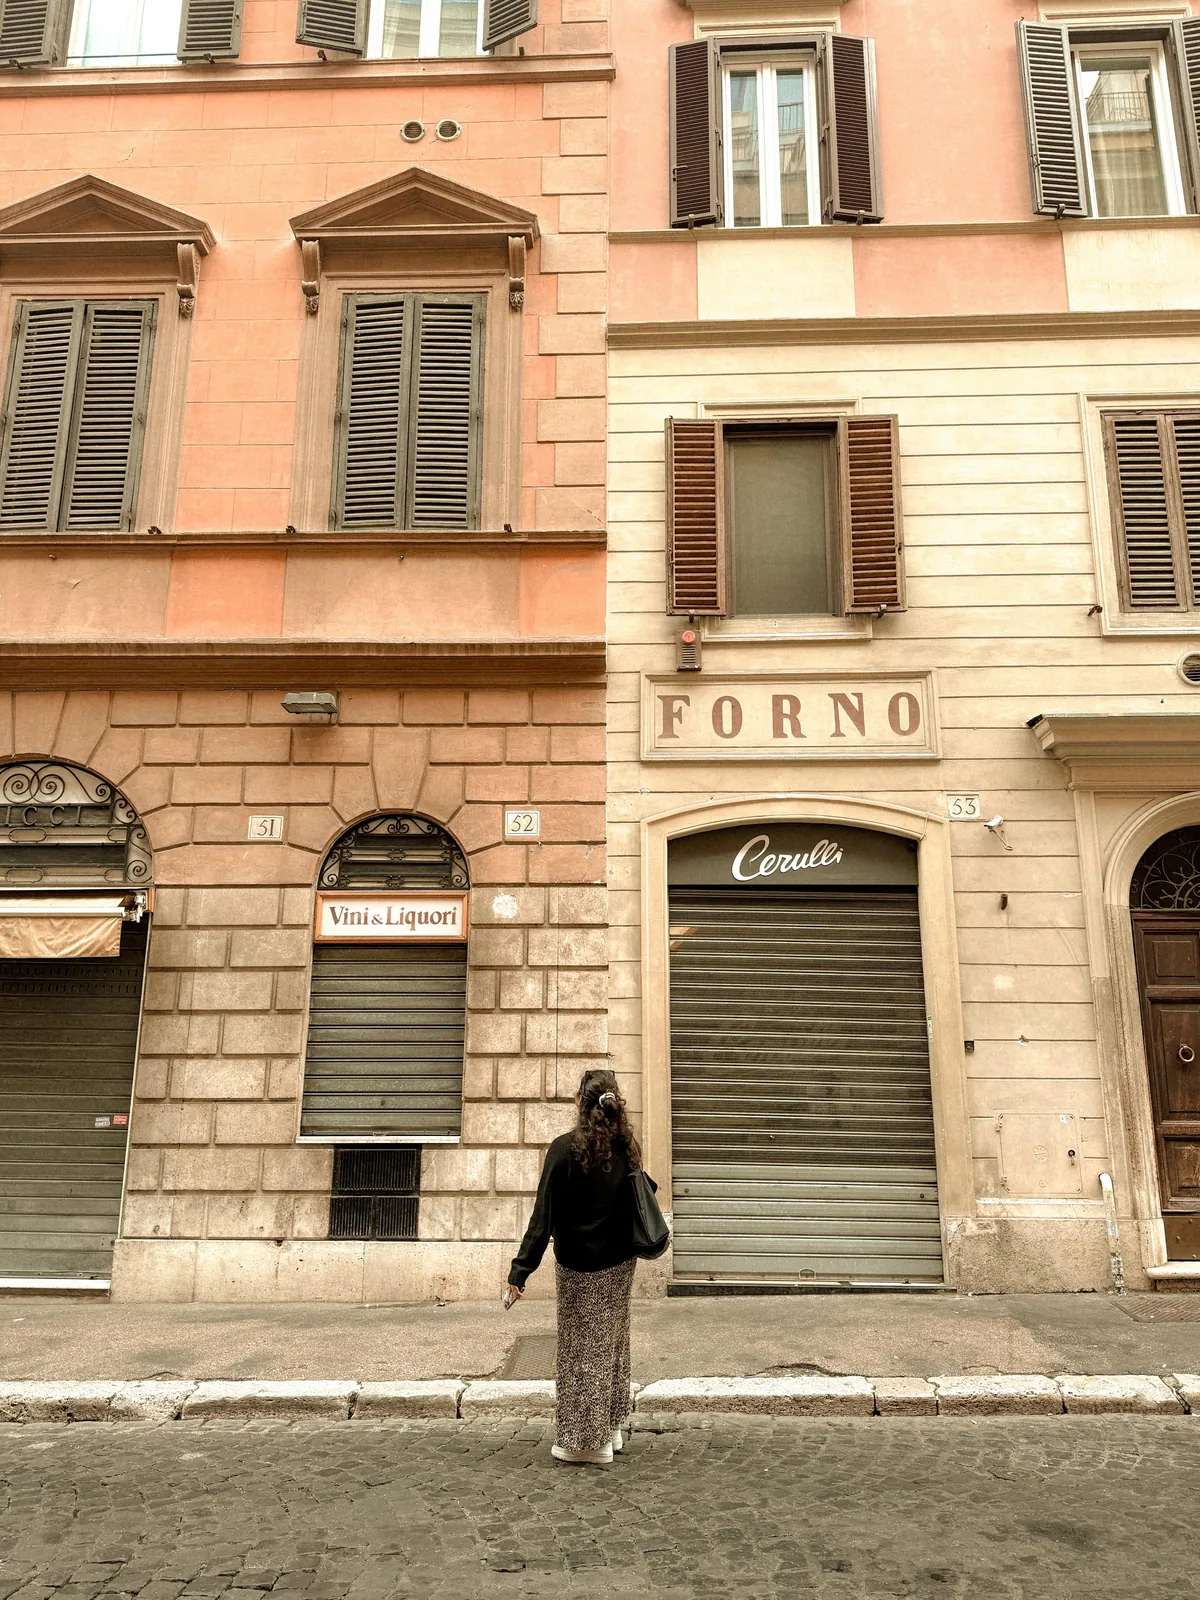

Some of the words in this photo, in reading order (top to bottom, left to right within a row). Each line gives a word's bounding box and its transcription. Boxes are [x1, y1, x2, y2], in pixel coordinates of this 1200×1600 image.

[656, 692, 921, 739] FORNO
[952, 797, 976, 816] 53
[257, 819, 276, 837] 51
[511, 814, 534, 832] 52
[731, 834, 844, 882] Cerulli
